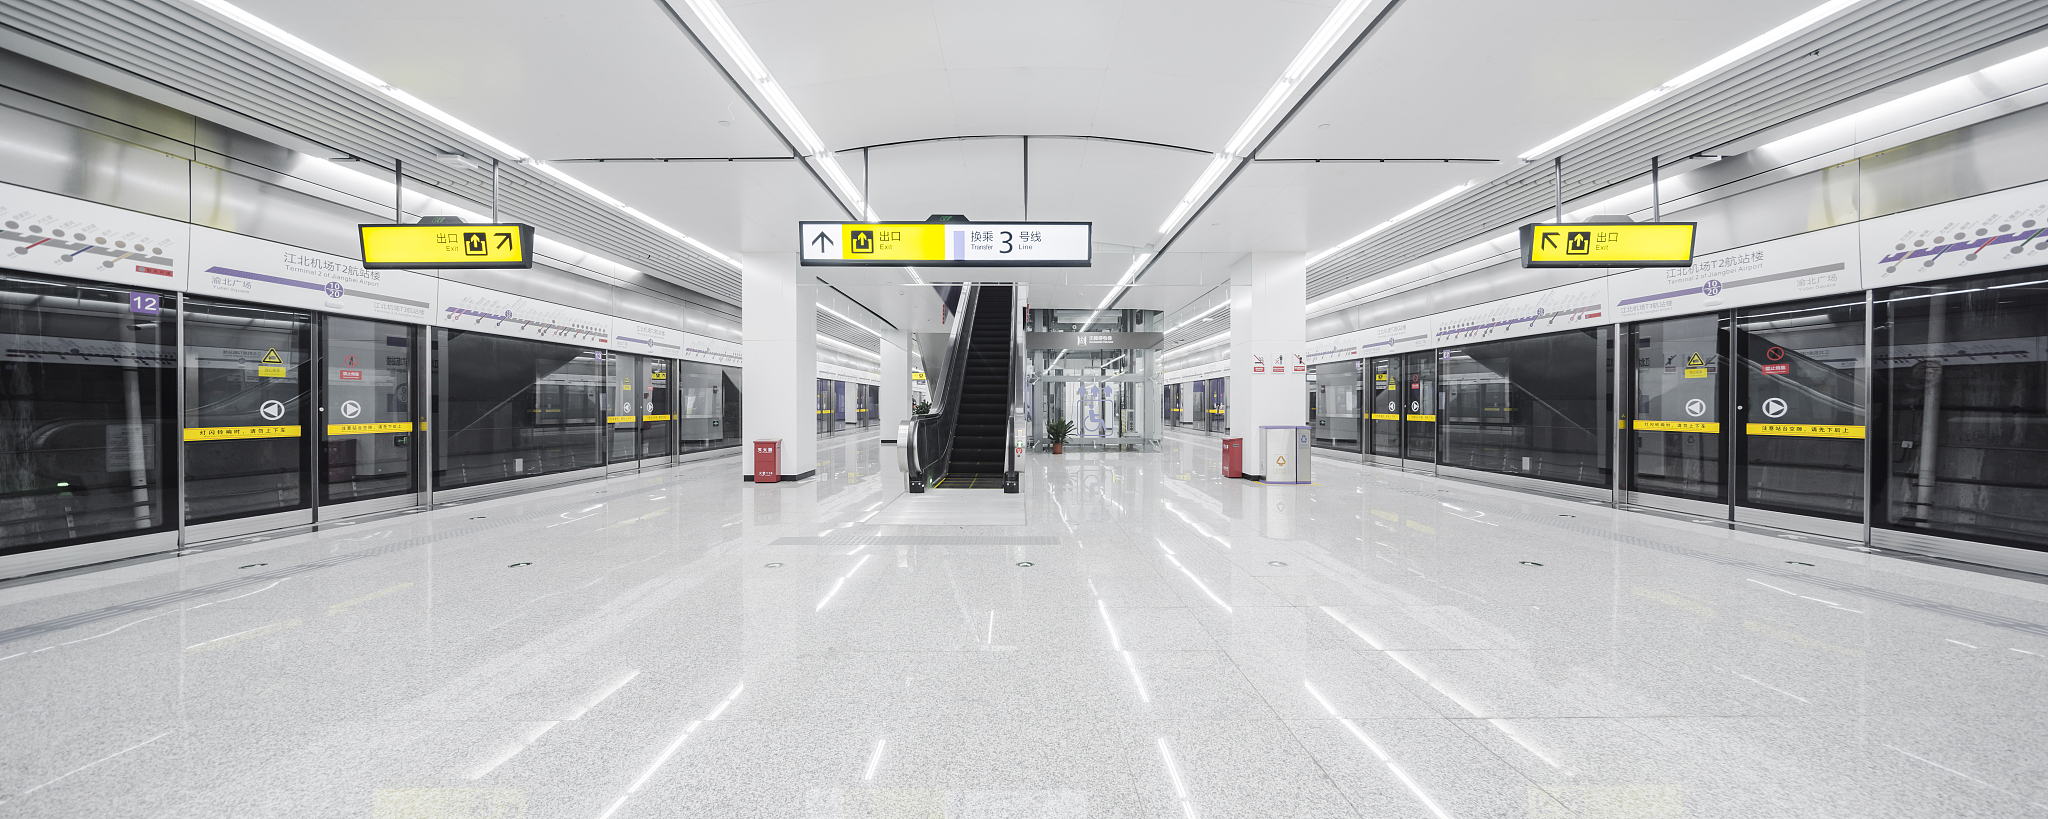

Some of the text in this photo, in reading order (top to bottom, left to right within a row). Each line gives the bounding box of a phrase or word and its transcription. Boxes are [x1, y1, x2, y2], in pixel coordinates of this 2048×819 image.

[436, 232, 458, 244] 出口
[880, 230, 900, 242] 出口
[970, 230, 1042, 254] 换乘 3 号线
[1596, 232, 1618, 242] 出口
[284, 252, 380, 282] 江北机场T2航站楼
[1666, 250, 1764, 278] 江北机场T2航站楼
[286, 264, 317, 276] Terminal
[330, 273, 358, 284] Jiangbei
[359, 278, 380, 288] Airport
[1668, 276, 1694, 285] Terminal
[1707, 268, 1737, 278] Jiangbei
[1738, 262, 1763, 272] Airport
[211, 276, 252, 289] 渝北广场
[330, 282, 340, 290] 10
[1707, 280, 1718, 288] 10
[1796, 274, 1838, 288] 渝北广场
[329, 290, 340, 298] 20
[1707, 288, 1718, 296] 20
[133, 296, 157, 311] 12
